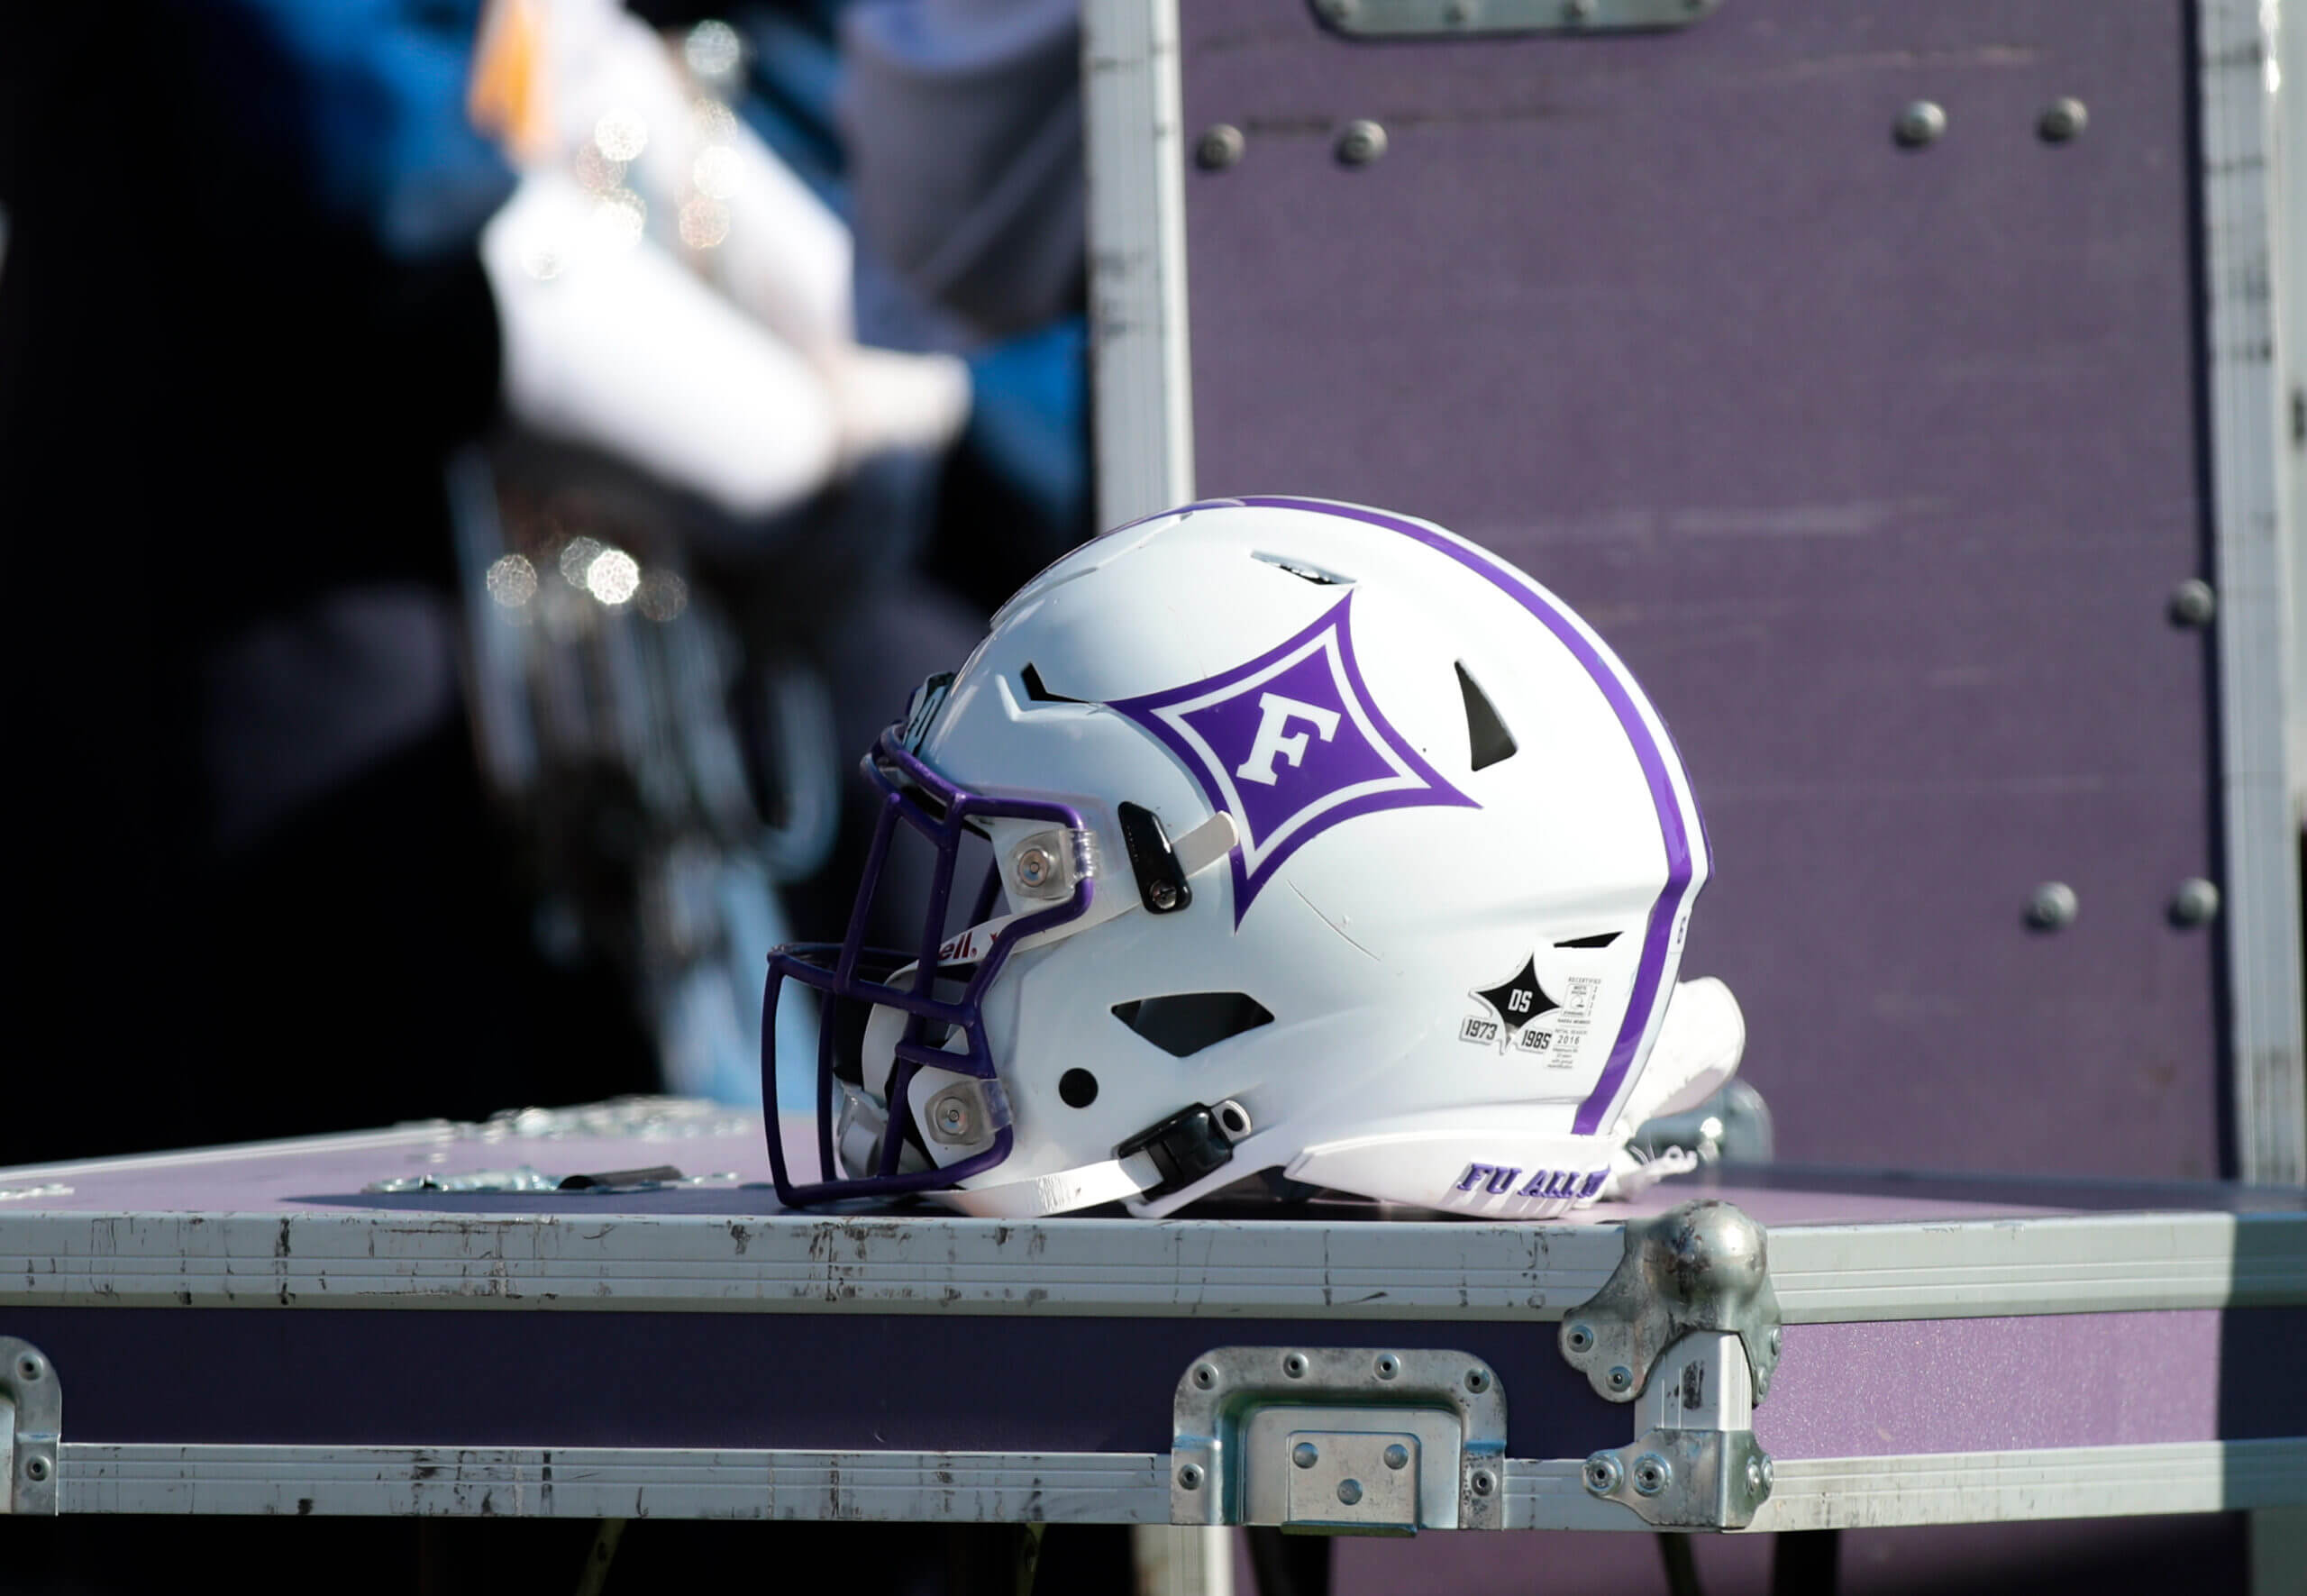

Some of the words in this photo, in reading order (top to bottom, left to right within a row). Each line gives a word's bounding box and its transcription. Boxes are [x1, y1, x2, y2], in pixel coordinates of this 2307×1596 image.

[1236, 692, 1341, 786] F
[1508, 989, 1533, 1013] DS
[1465, 1018, 1498, 1040] 1973
[1521, 1029, 1552, 1049] 1985
[1456, 1163, 1523, 1194] FU
